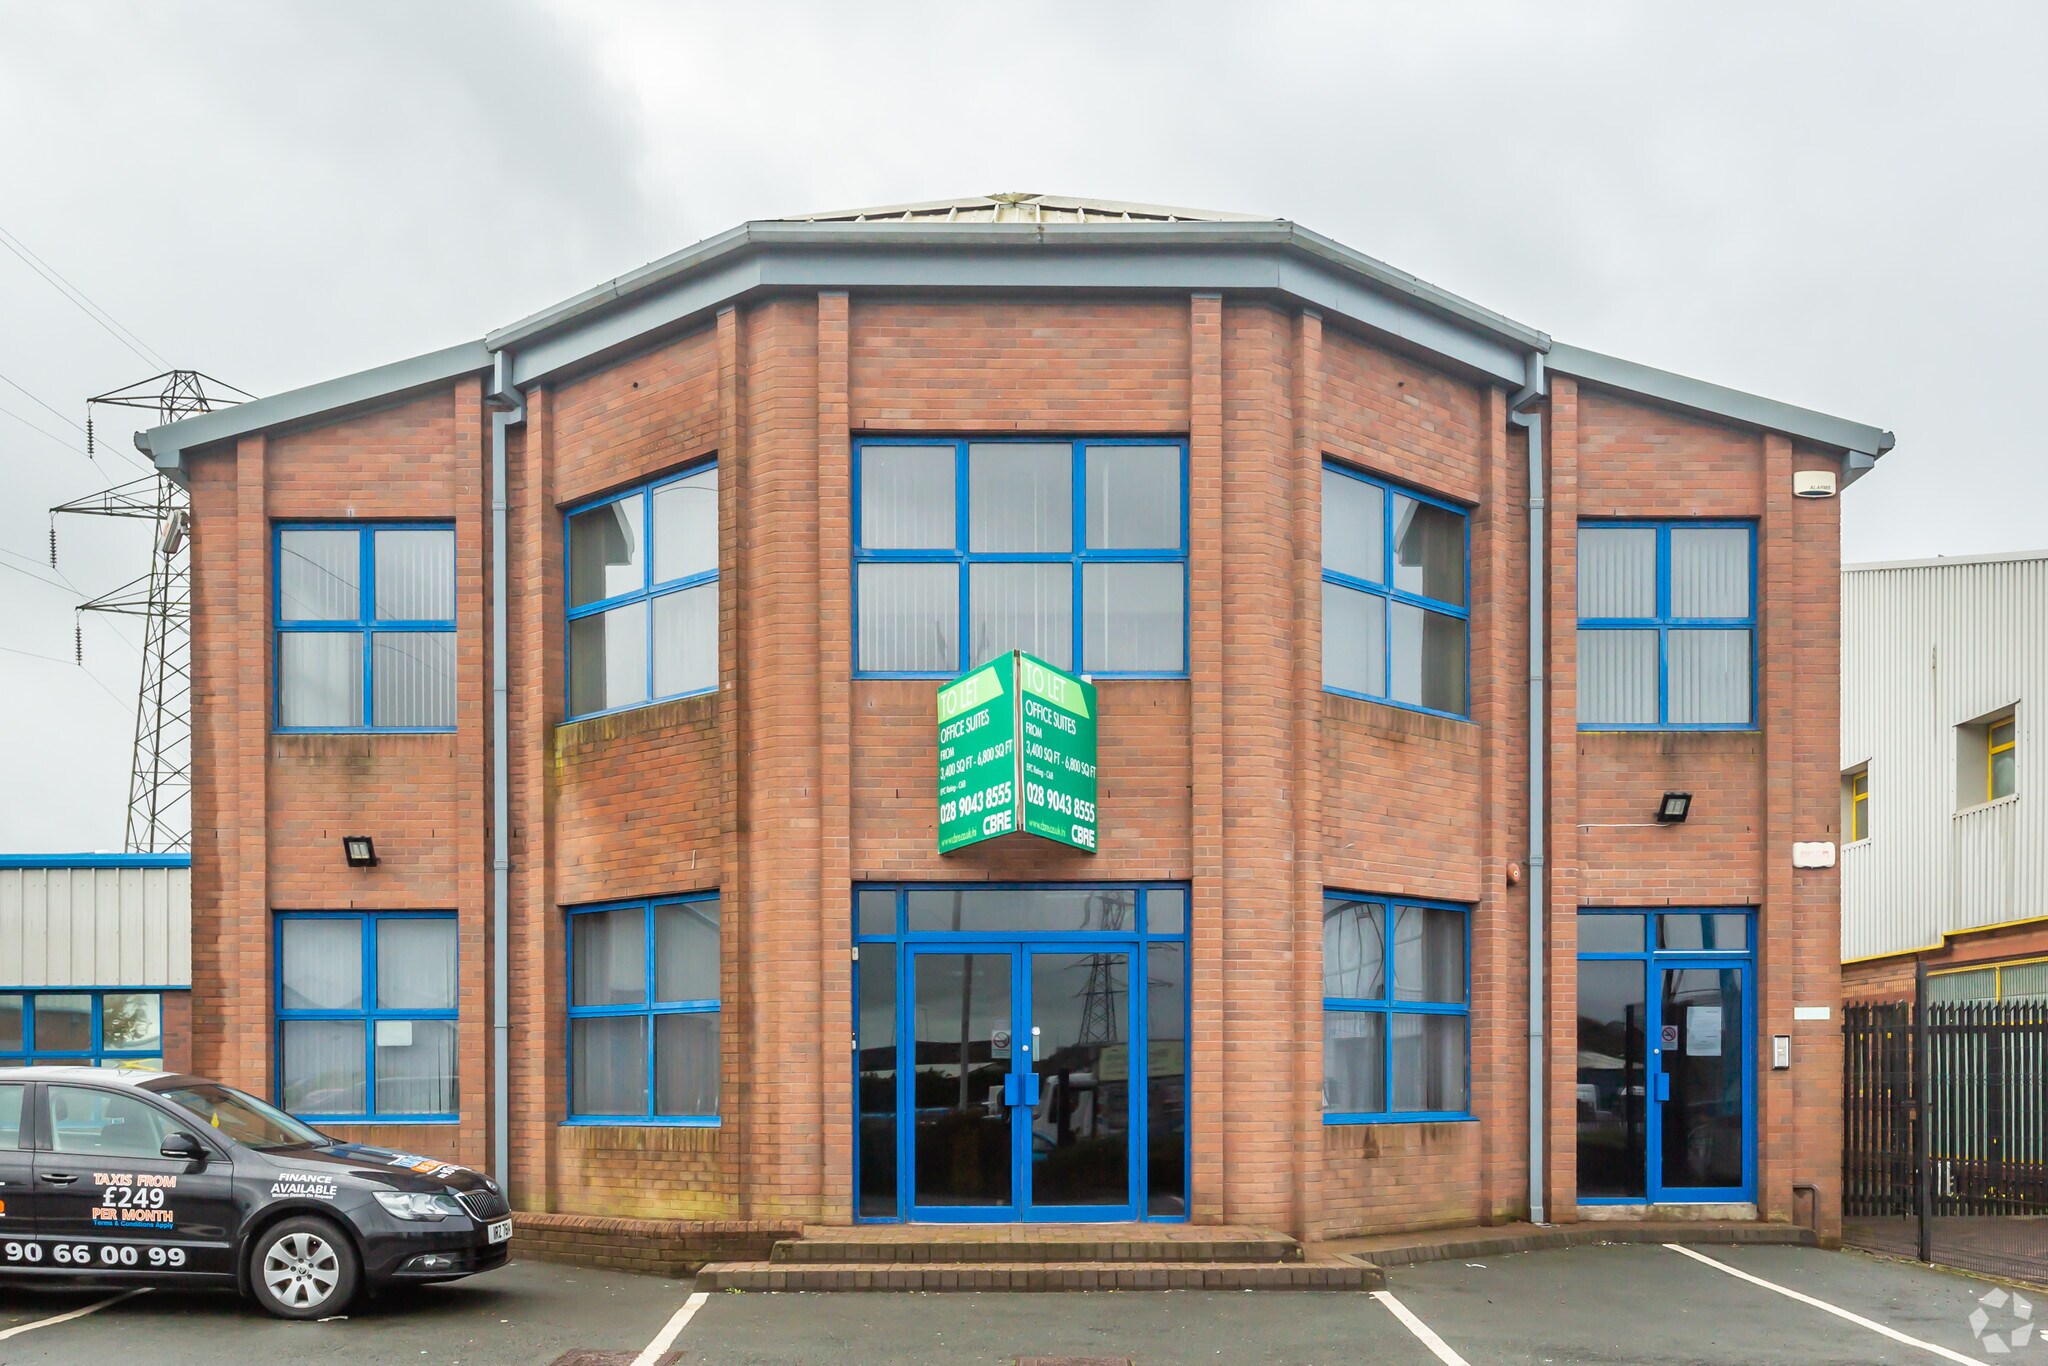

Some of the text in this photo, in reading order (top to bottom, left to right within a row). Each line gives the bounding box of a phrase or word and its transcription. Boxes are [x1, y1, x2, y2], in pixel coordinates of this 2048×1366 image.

[1025, 662, 1066, 704] TO LET
[940, 677, 979, 718] TO LET
[940, 709, 990, 744] OFFICE SUITES
[1025, 699, 1076, 735] OFFICE SUITES
[1026, 722, 1042, 739] FROM
[940, 746, 955, 761] FROM
[940, 763, 956, 781] 3,400
[956, 760, 965, 775] SQ
[965, 755, 973, 771] FT
[977, 750, 994, 767] 6,800
[995, 745, 1004, 760] SQ
[1005, 739, 1013, 754] FT
[1026, 740, 1043, 759] 3,400
[1043, 748, 1053, 763] SQ
[1053, 751, 1061, 765] FT
[1064, 755, 1080, 774] 6,800
[1081, 762, 1090, 777] SQ
[1090, 766, 1096, 779] FT
[940, 781, 1012, 824] 028 9043 8555
[1026, 781, 1095, 823] 028 9043 8555
[982, 810, 1012, 835] CBRE
[1071, 824, 1095, 848] CBRE
[93, 1173, 177, 1188] TAXIS FROM
[270, 1182, 338, 1196] AVAILABLE
[279, 1172, 333, 1184] FINANCE
[102, 1186, 164, 1209] £249
[92, 1207, 174, 1222] PER MONTH
[120, 1220, 154, 1228] Conditions
[155, 1221, 174, 1230] Apply
[5, 1242, 187, 1267] 90 66 00 99
